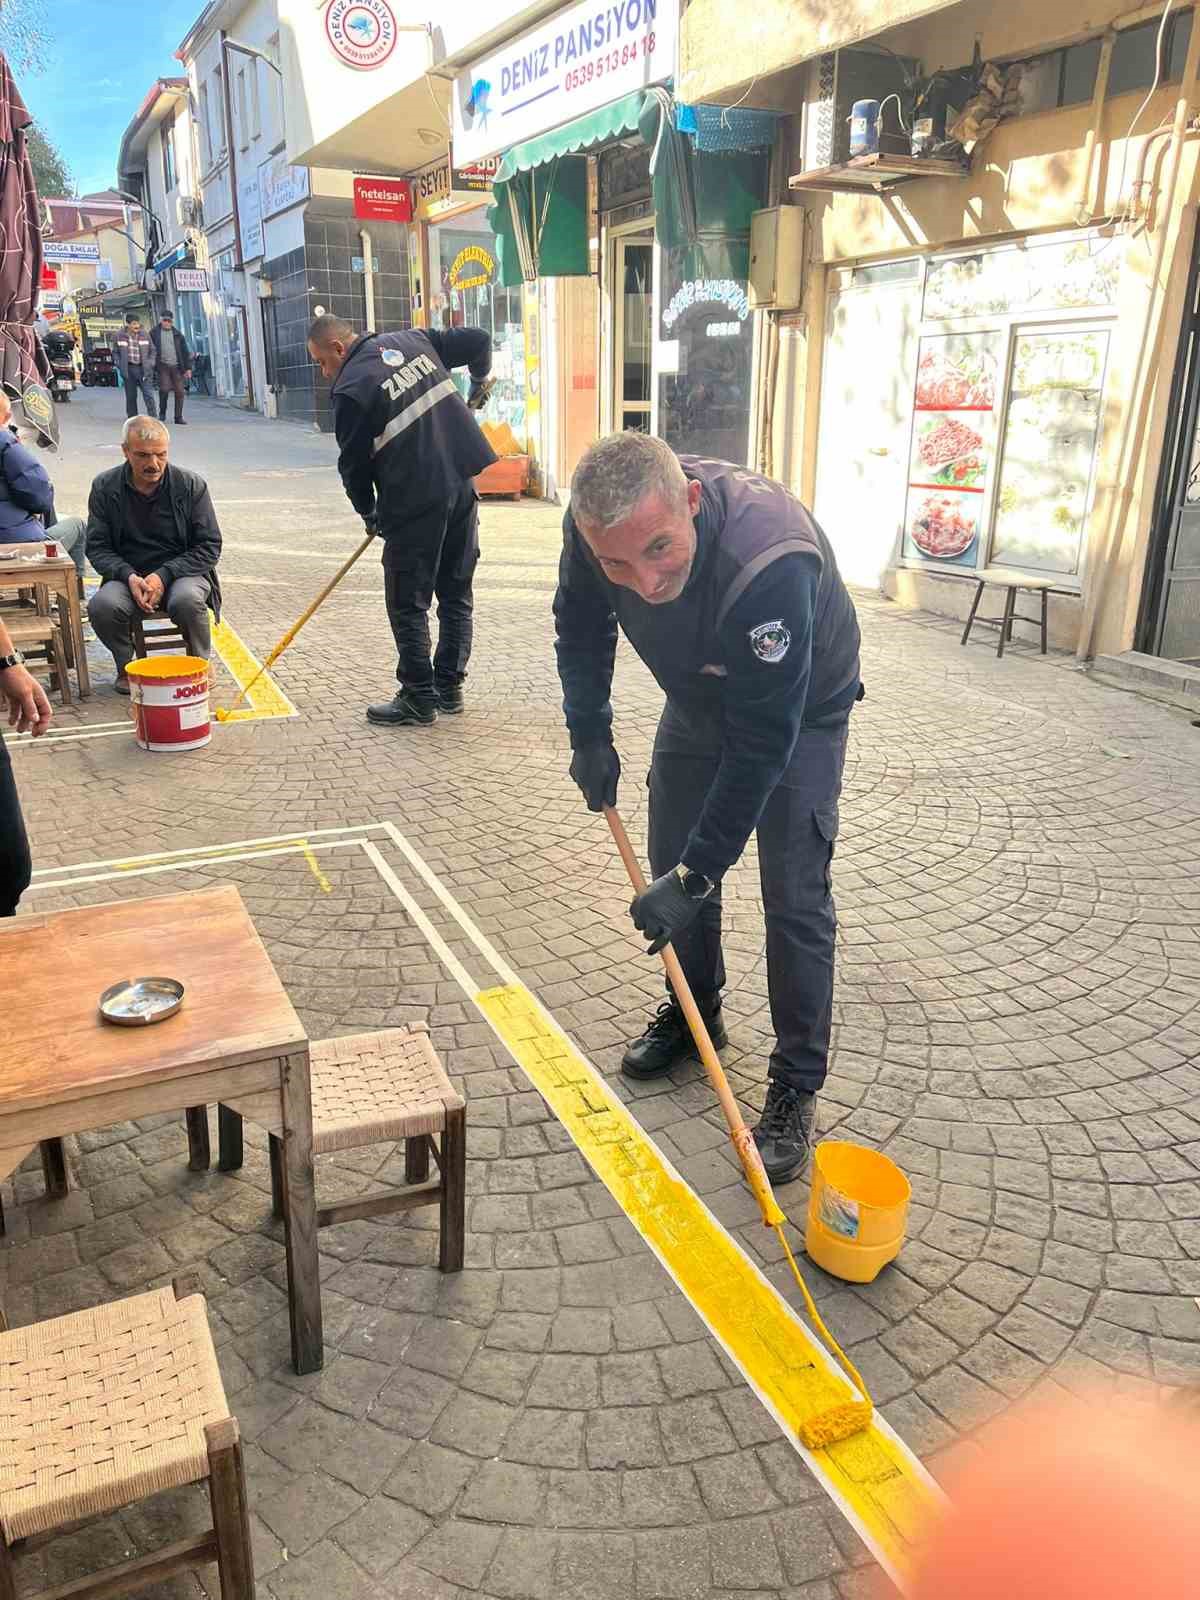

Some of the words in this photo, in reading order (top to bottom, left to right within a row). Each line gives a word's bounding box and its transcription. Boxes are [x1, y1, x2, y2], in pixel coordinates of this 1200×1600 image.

[564, 62, 595, 92] 0539
[595, 50, 619, 79] 513
[621, 40, 638, 67] 84
[639, 31, 657, 58] 18
[381, 354, 438, 401] ZABITA
